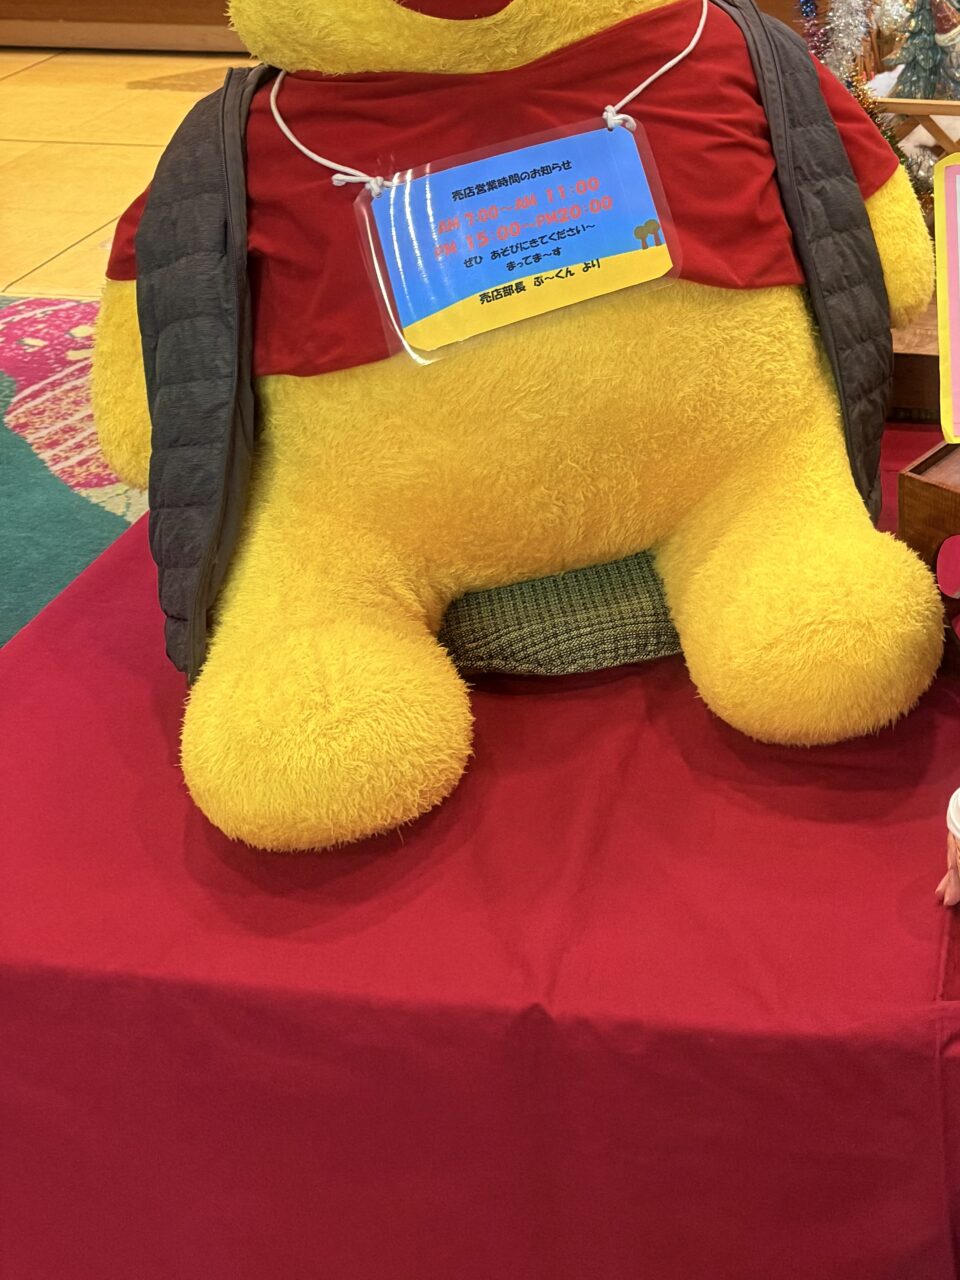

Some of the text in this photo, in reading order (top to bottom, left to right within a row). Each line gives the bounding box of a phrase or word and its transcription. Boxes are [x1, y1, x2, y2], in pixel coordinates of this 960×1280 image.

[451, 159, 573, 202] 売店営業時間のお知らせ
[438, 216, 460, 235] AM
[463, 254, 484, 269] ぜひ
[506, 246, 562, 272] まってま〜す
[478, 280, 527, 306] 売店部長
[582, 258, 601, 273] より
